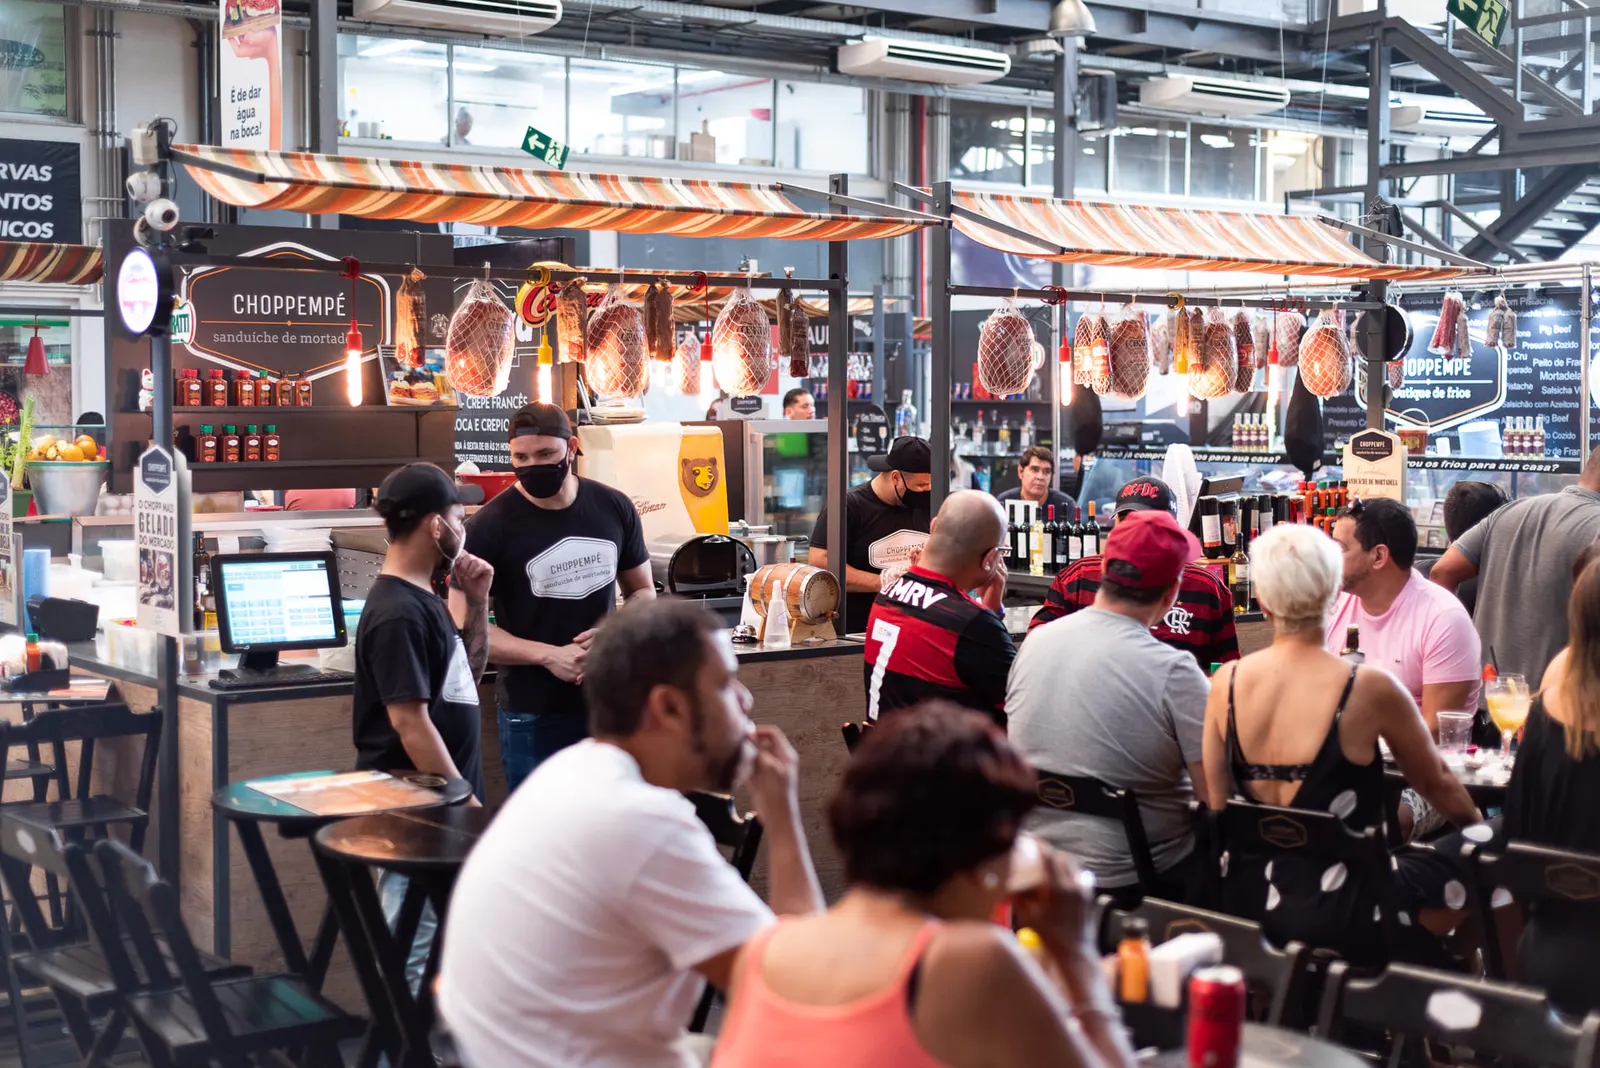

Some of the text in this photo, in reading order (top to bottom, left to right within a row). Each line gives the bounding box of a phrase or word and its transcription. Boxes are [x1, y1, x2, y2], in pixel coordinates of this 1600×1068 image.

[230, 85, 261, 103] É de dar
[236, 106, 255, 124] água
[230, 121, 262, 140] na boca!
[0, 220, 55, 239] ICOS
[233, 292, 346, 317] CHOPPEMPÉ
[213, 330, 280, 344] sanduíche
[281, 331, 297, 344] de
[1539, 324, 1572, 336] Pig Beef
[1522, 341, 1553, 350] Presunto
[1554, 341, 1579, 350] Cozido
[1513, 351, 1528, 361] Cru
[1533, 357, 1553, 368] Peito
[1554, 358, 1564, 367] de
[1432, 386, 1446, 399] de
[1447, 386, 1472, 399] frios
[1541, 385, 1573, 395] Salsicha
[466, 395, 490, 409] CREPE
[454, 418, 473, 432] OCA
[474, 418, 480, 432] E
[1551, 413, 1570, 423] Beef
[1552, 431, 1577, 440] Cozido
[1208, 454, 1231, 463] para
[1251, 455, 1282, 463] casa?
[1440, 460, 1467, 469] frios
[1468, 461, 1496, 471] para
[1498, 462, 1520, 470] sua
[1521, 463, 1560, 472] casa?
[138, 511, 175, 537] GELADO
[138, 534, 175, 550] DO MERCADO
[550, 552, 602, 575] CHOPPEMPÉ
[888, 577, 948, 610] MRV
[869, 618, 901, 720] 7
